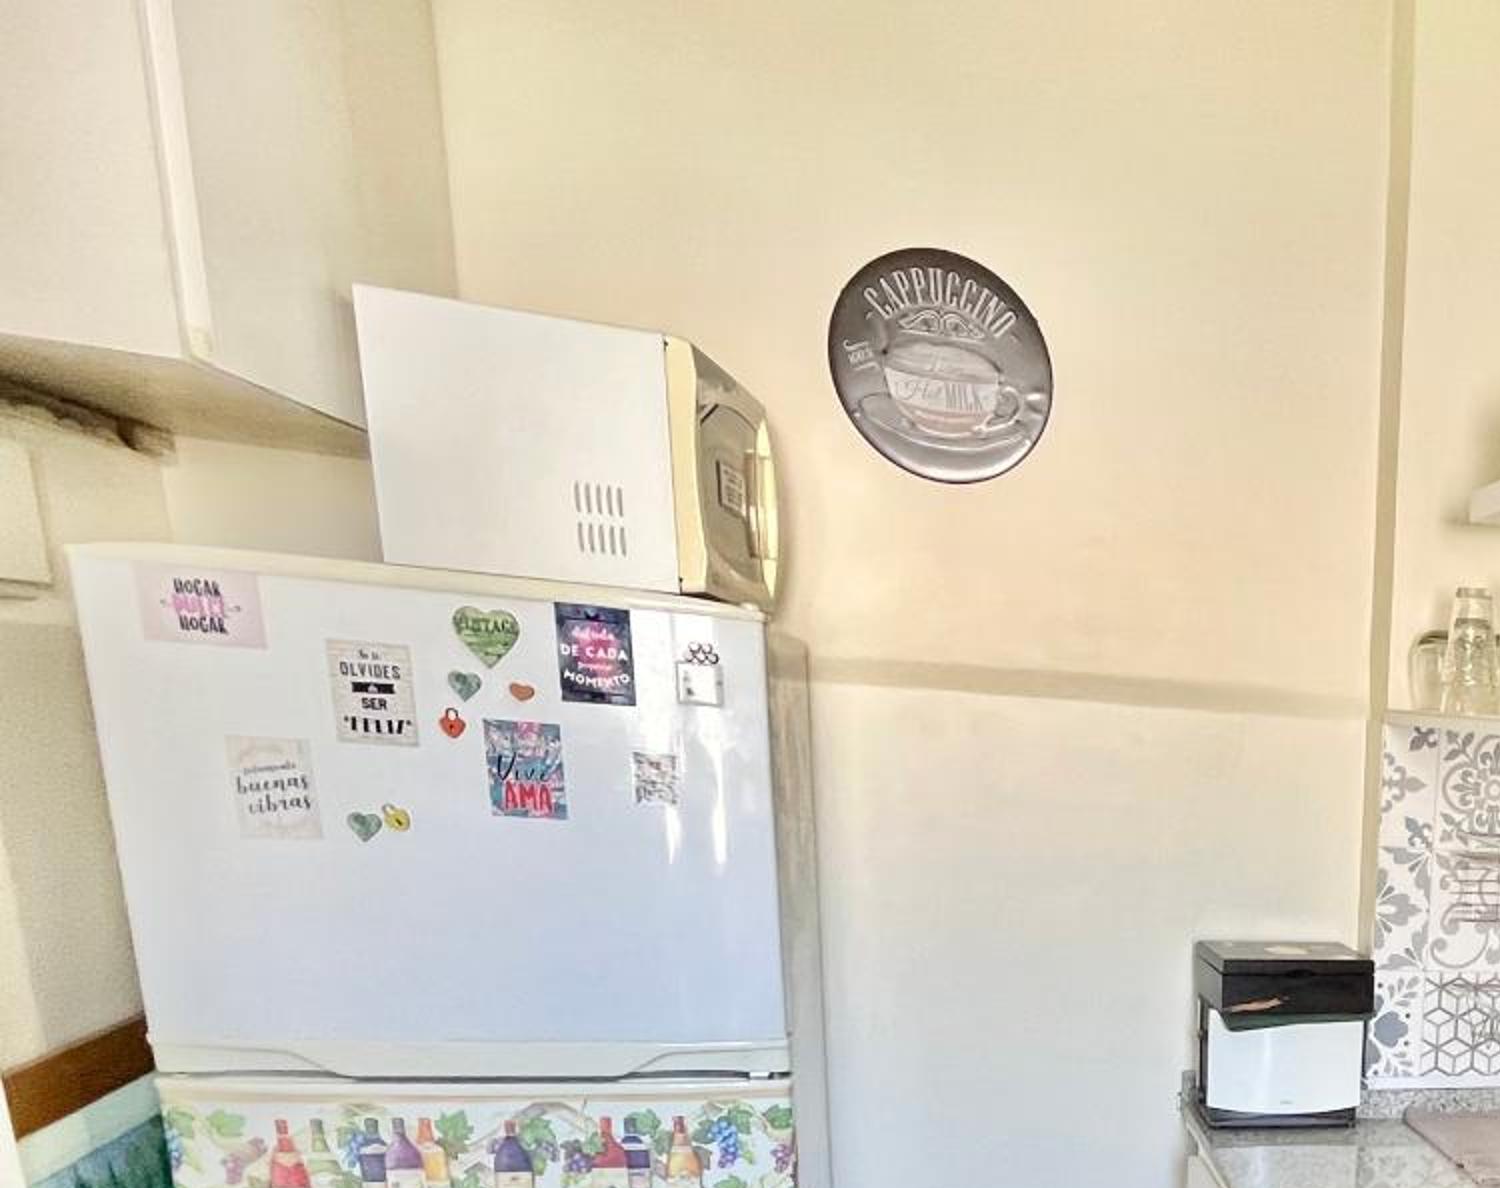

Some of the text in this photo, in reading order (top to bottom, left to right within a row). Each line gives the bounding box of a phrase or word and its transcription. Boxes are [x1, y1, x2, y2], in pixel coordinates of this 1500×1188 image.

[863, 266, 1017, 338] CAPPUCCINO
[560, 643, 628, 661] DE CADA
[339, 660, 401, 680] OLVIDES
[563, 668, 631, 689] MOMENTO
[361, 697, 388, 711] SER
[236, 774, 309, 794] buenas
[505, 780, 553, 815] AMA
